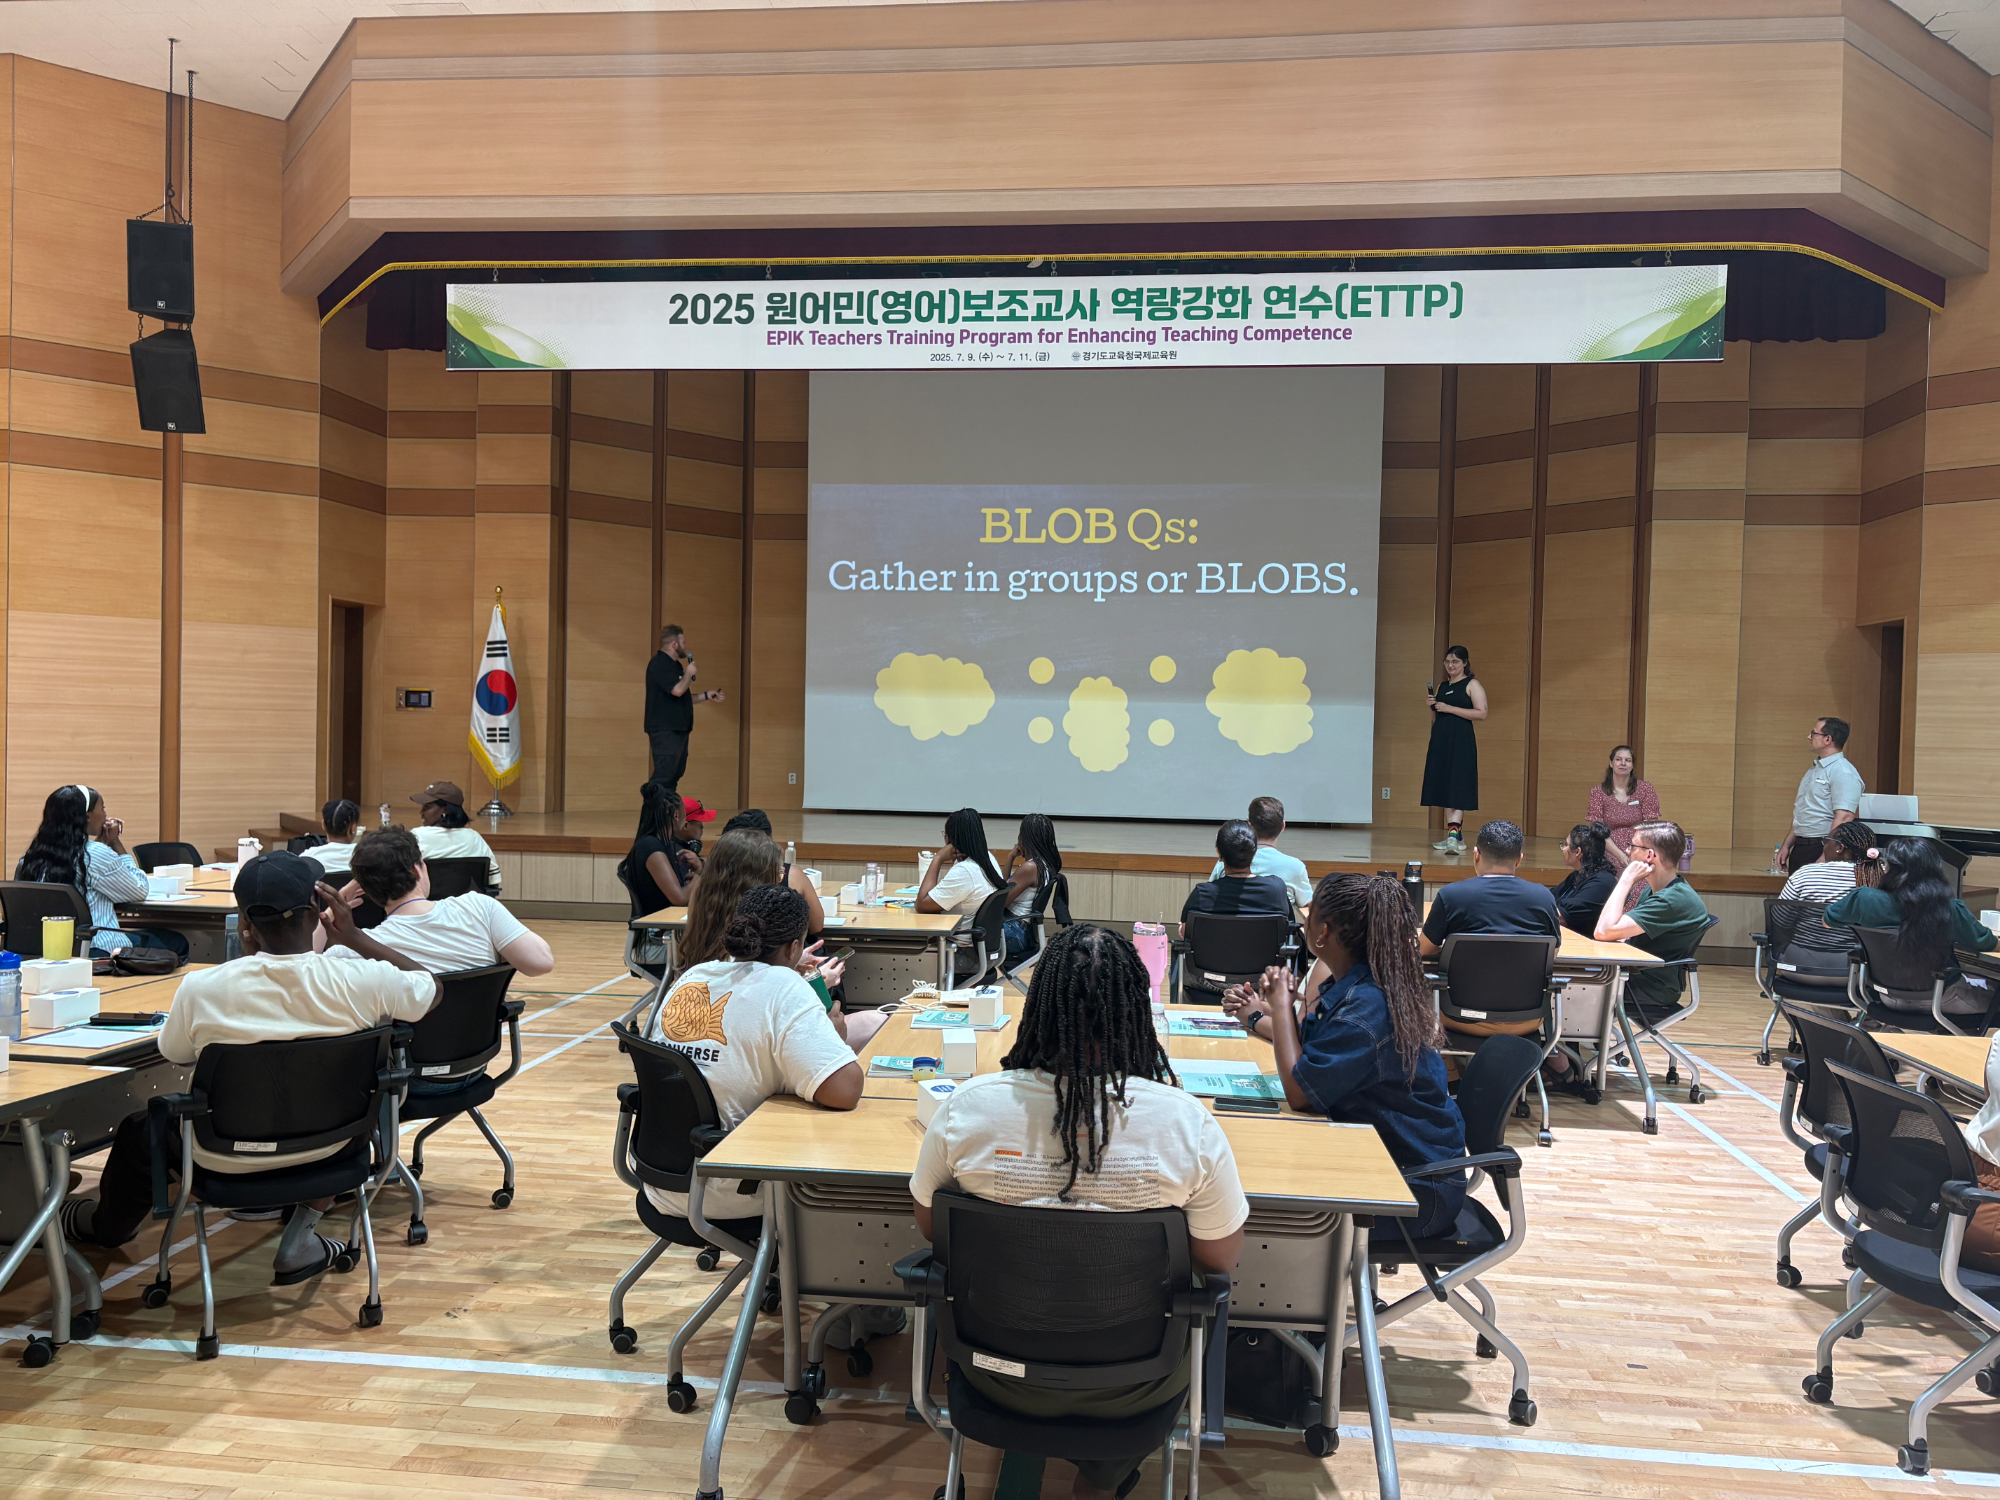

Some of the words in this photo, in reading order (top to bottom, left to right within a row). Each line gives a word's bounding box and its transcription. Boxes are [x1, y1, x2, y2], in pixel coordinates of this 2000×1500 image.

[668, 293, 755, 325] 2025
[765, 287, 1101, 326] 원어민(영어)보조교사
[1110, 285, 1253, 322] 역량강화
[1263, 281, 1464, 320] 연수(ETTP)
[766, 330, 805, 346] EPIK
[808, 330, 883, 346] Teachers
[886, 329, 955, 348] Training
[959, 328, 1033, 348] Program
[1037, 327, 1064, 344] for
[1067, 326, 1157, 346] Enhancing
[1161, 325, 1239, 345] Teaching
[1243, 325, 1353, 343] Competence
[930, 353, 954, 362] 2025.
[957, 353, 965, 362] 7.
[967, 353, 976, 362] 9.
[978, 352, 994, 362] (수)
[1007, 353, 1016, 362] 7.
[1019, 352, 1032, 362] 11.
[1035, 351, 1050, 362] (금)
[1082, 350, 1178, 361] 경기도교육청국제교육원
[979, 507, 1118, 544] BLOB
[1127, 508, 1199, 551] Qs:
[828, 560, 957, 592] Gather
[964, 561, 1001, 592] in
[1008, 568, 1138, 603] groups
[1146, 571, 1188, 594] or
[1195, 562, 1359, 596] BLOBS.
[654, 1041, 720, 1062] VERSE
